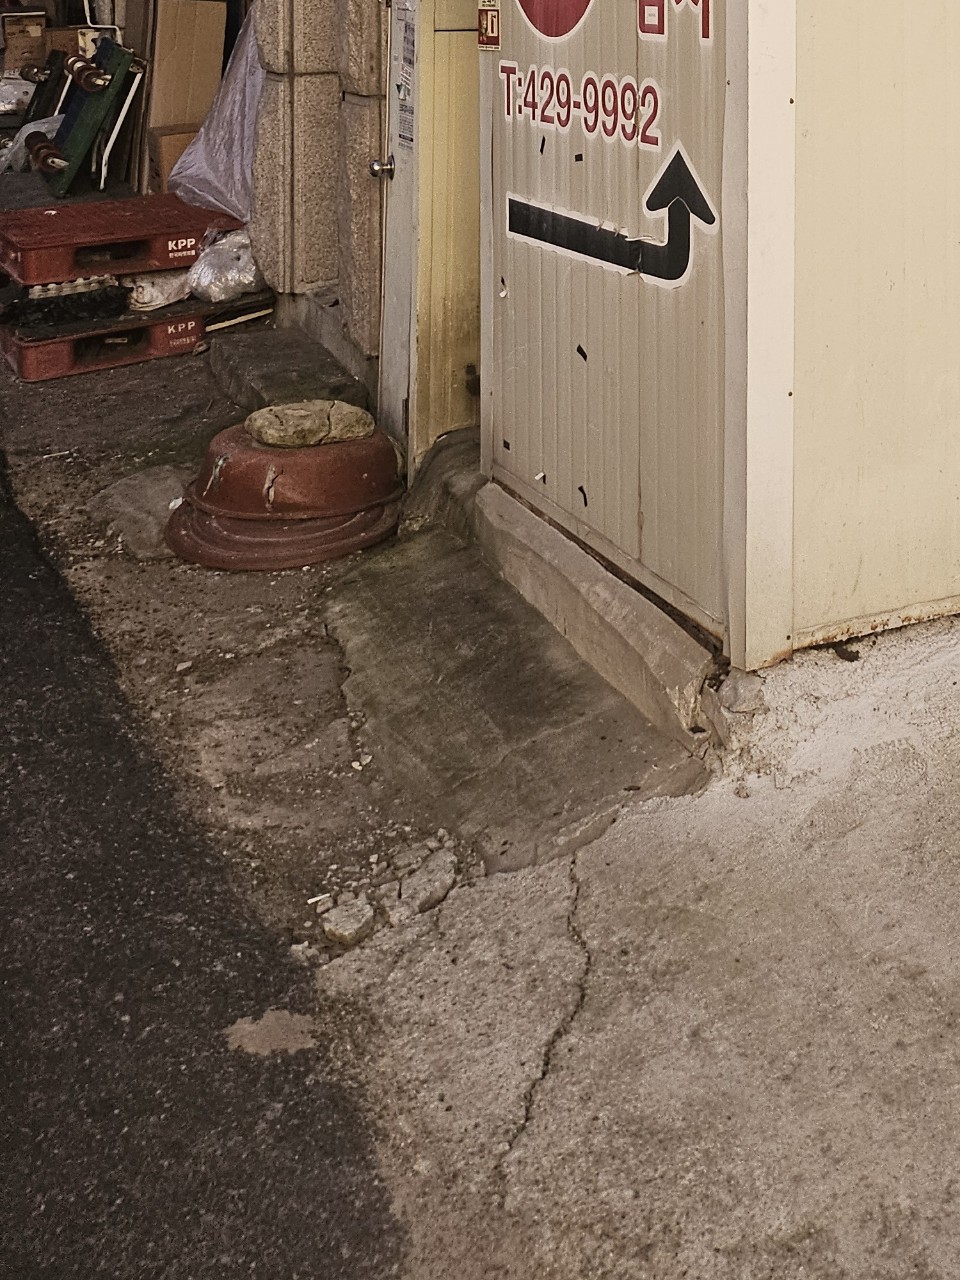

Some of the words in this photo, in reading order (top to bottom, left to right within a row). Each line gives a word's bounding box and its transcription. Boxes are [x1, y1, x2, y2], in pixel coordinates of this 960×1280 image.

[501, 65, 659, 146] T:429-9992
[168, 238, 196, 250] KPP
[167, 321, 195, 334] KPP
